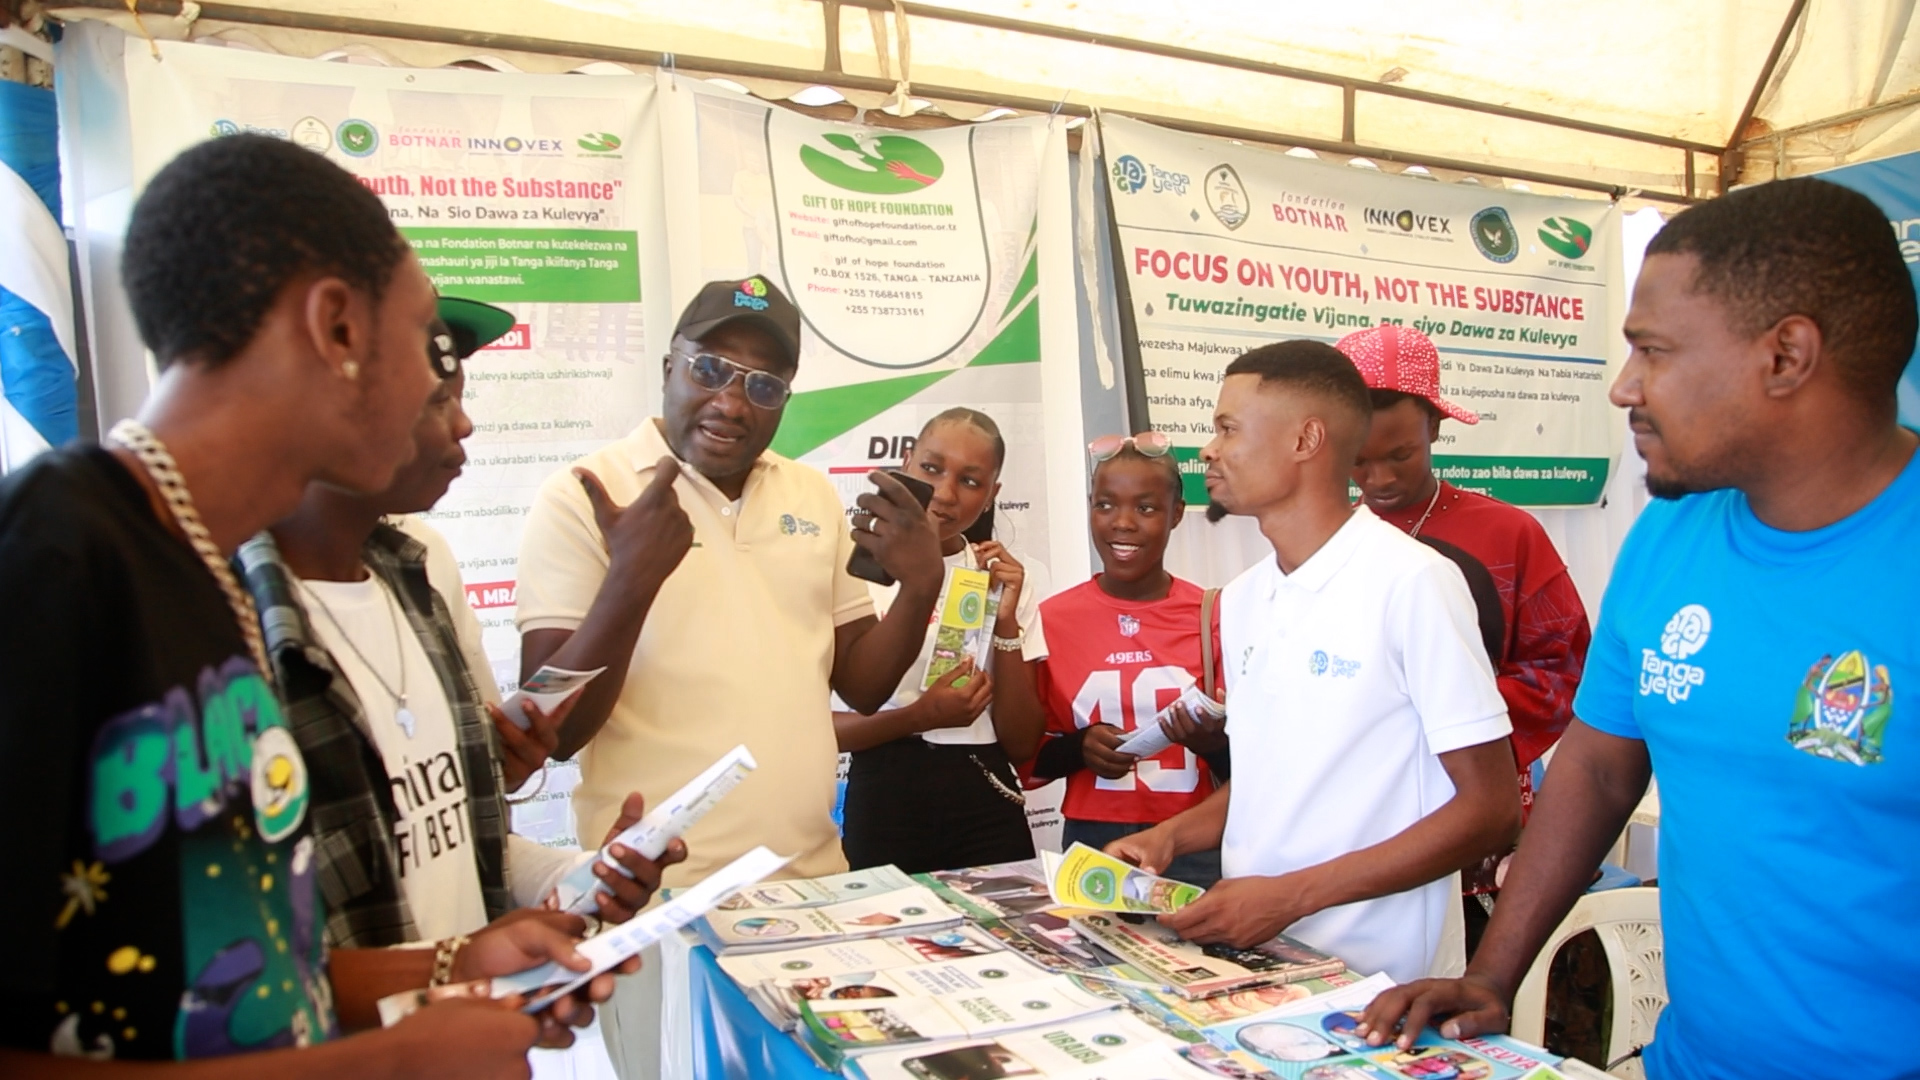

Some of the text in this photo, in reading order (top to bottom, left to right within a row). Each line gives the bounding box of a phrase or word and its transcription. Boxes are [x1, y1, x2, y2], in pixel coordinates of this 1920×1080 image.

[389, 134, 463, 149] BOTNAR
[468, 136, 563, 152] INNOVEX
[1148, 162, 1190, 187] Tanga
[350, 173, 623, 201] outh, Not the Substance"
[802, 194, 954, 217] GIFT OF HOPE FOUNDATION
[1280, 190, 1347, 211] fondation
[390, 207, 414, 220] na,
[418, 206, 440, 219] Na
[448, 206, 471, 219] Sio
[476, 206, 519, 220] Dawa
[523, 210, 538, 220] za
[788, 210, 830, 226] Website:
[1272, 203, 1349, 233] BOTNAR
[1363, 206, 1452, 235] INNOVEX
[791, 227, 821, 240] Email:
[425, 239, 439, 249] na
[441, 237, 496, 250] Fondation
[498, 238, 534, 250] Botnar
[536, 241, 550, 251] na
[551, 239, 613, 252] kutekelezwa
[615, 242, 628, 252] na
[418, 256, 469, 268] mashauri
[470, 258, 483, 270] ya
[499, 256, 509, 268] la
[511, 256, 543, 271] Tanga
[588, 257, 619, 272] Tanga
[852, 257, 861, 265] of
[865, 258, 889, 270] hope
[893, 259, 946, 269] foundation
[465, 273, 525, 286] wanastawi.
[883, 272, 919, 283] TANGA
[929, 273, 981, 283] TANZANIA
[1135, 246, 1585, 321] FOCUS ON YOUTH, NOT THE SUBSTANCE
[807, 282, 841, 295] Phone:
[843, 287, 867, 298] +255
[845, 304, 869, 315] +255
[1165, 292, 1308, 323] Tuwazingatie
[1412, 315, 1447, 337] siyo
[1450, 319, 1495, 340] Dawa
[1498, 327, 1516, 342] za
[1519, 328, 1579, 350] Kulevya
[488, 329, 524, 348] ADI
[1138, 339, 1243, 356] wezesha Majukwaa
[469, 371, 508, 383] kulevya
[510, 369, 545, 382] kupitia
[1160, 367, 1190, 380] elimu
[1193, 369, 1215, 382] kwa
[1439, 360, 1452, 371] idi
[1456, 361, 1466, 371] Ya
[1469, 363, 1493, 374] Dawa
[1494, 364, 1505, 374] Za
[1505, 365, 1536, 379] Kulevya
[1538, 368, 1550, 378] Na
[1550, 368, 1572, 379] Tabia
[463, 388, 479, 400] aji.
[1450, 388, 1460, 396] za
[1507, 390, 1516, 399] na
[1517, 389, 1539, 401] dawa
[1540, 393, 1550, 401] za
[1550, 391, 1581, 404] kulevya
[1189, 396, 1215, 410] afya,
[1478, 411, 1498, 421] umla
[475, 421, 495, 432] mizi
[498, 423, 510, 434] ya
[511, 420, 539, 431] dawa
[541, 421, 552, 429] za
[1150, 422, 1214, 434] ezesha Viku
[1438, 434, 1456, 445] evya
[474, 458, 487, 467] na
[489, 453, 536, 466] ukarabati
[539, 452, 559, 463] kwa
[1442, 465, 1471, 479] ndoto
[1472, 468, 1491, 480] zao
[1492, 465, 1512, 479] bila
[1512, 466, 1539, 480] dawa
[1540, 469, 1552, 480] za
[1553, 467, 1588, 482] kulevya
[467, 557, 498, 570] vijana
[467, 590, 480, 606] A
[481, 617, 500, 628] siku
[1104, 650, 1153, 664] 49ERS
[1640, 648, 1705, 686] Tanga
